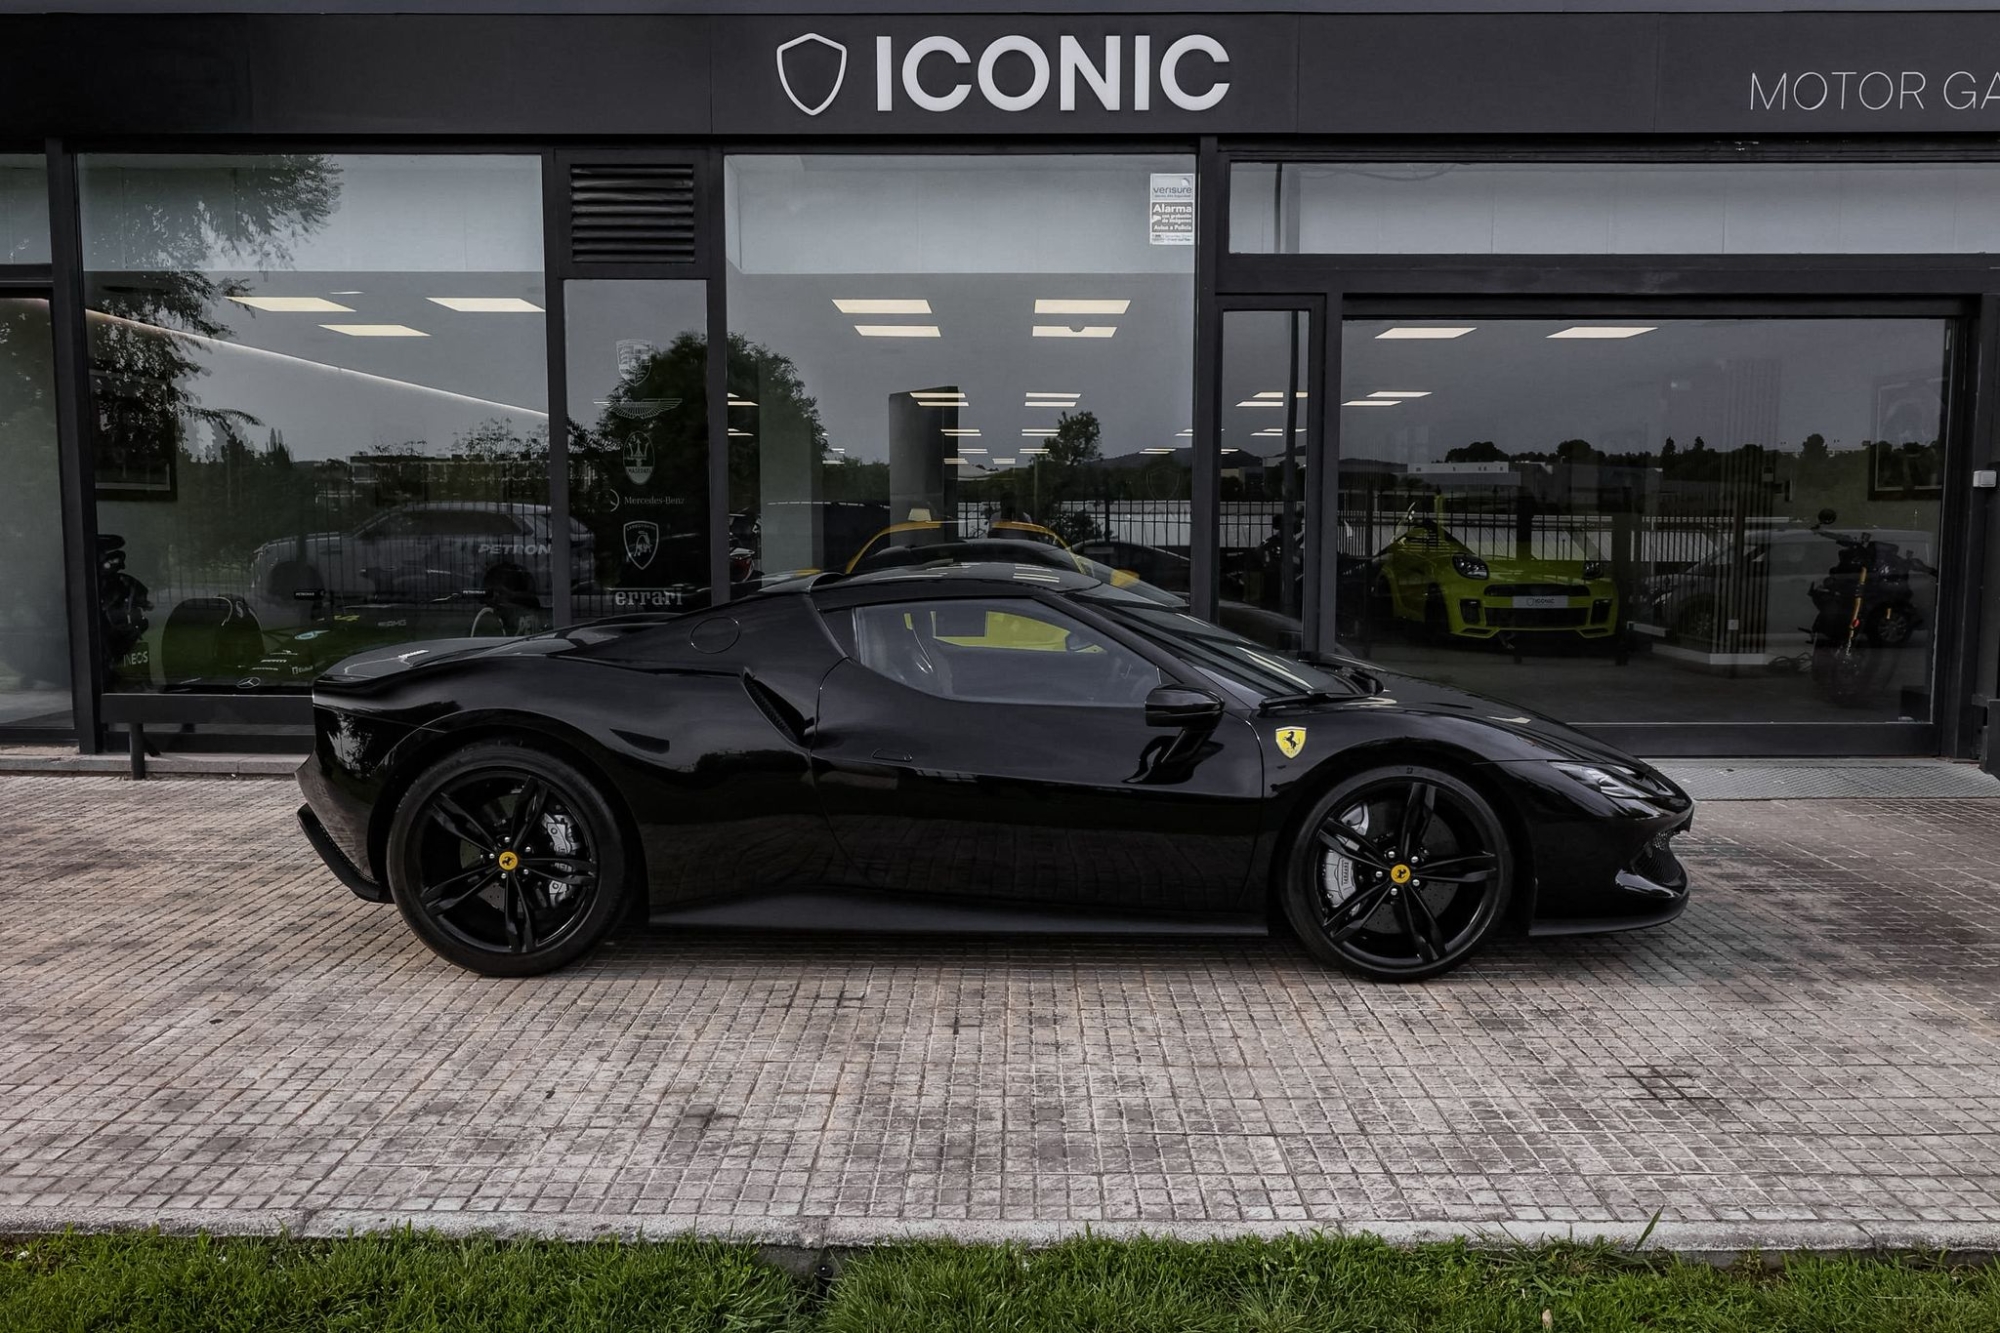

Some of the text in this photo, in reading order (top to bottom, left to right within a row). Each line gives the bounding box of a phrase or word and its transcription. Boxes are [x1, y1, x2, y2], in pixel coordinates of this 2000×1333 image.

[877, 35, 1231, 111] ICONIC
[1750, 71, 1926, 111] MOTOR
[1153, 186, 1192, 194] verisure
[1152, 203, 1192, 213] Alarma
[624, 495, 685, 505] Mercedes-Benz
[123, 650, 148, 668] INEOS
